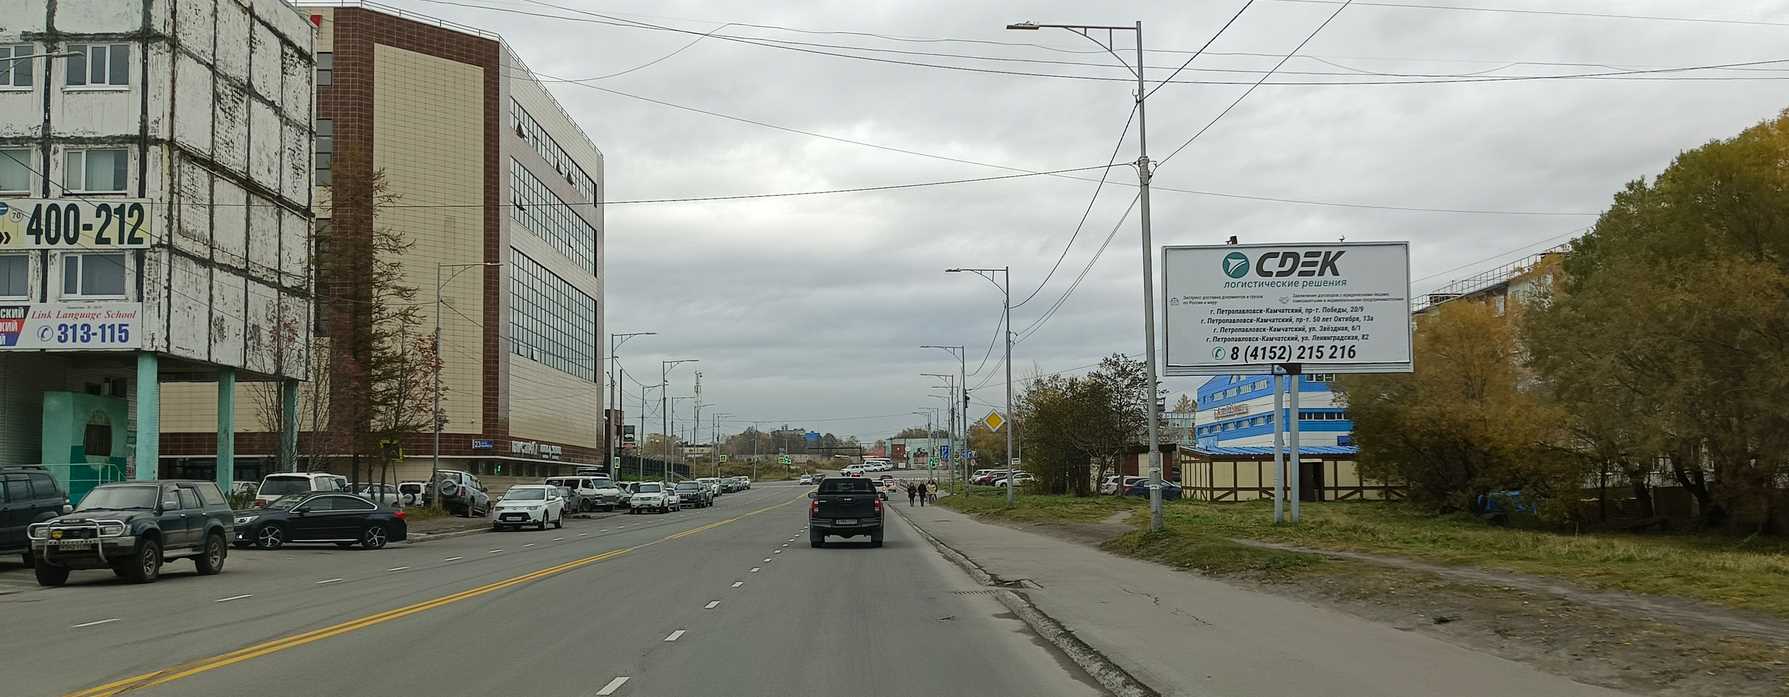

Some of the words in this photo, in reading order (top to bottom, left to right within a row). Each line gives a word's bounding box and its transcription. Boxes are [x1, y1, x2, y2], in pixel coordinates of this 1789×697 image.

[26, 203, 145, 245] 400-212
[1255, 251, 1346, 277] CDEK
[1224, 280, 1300, 288] логистические
[1301, 279, 1347, 289] решения
[32, 311, 52, 319] Link
[56, 310, 101, 320] Language
[104, 310, 137, 319] School
[57, 323, 130, 343] 313-115
[1231, 346, 1239, 360] 8
[1244, 345, 1292, 363] (4152)
[1297, 345, 1325, 360] 215
[1329, 344, 1357, 359] 216
